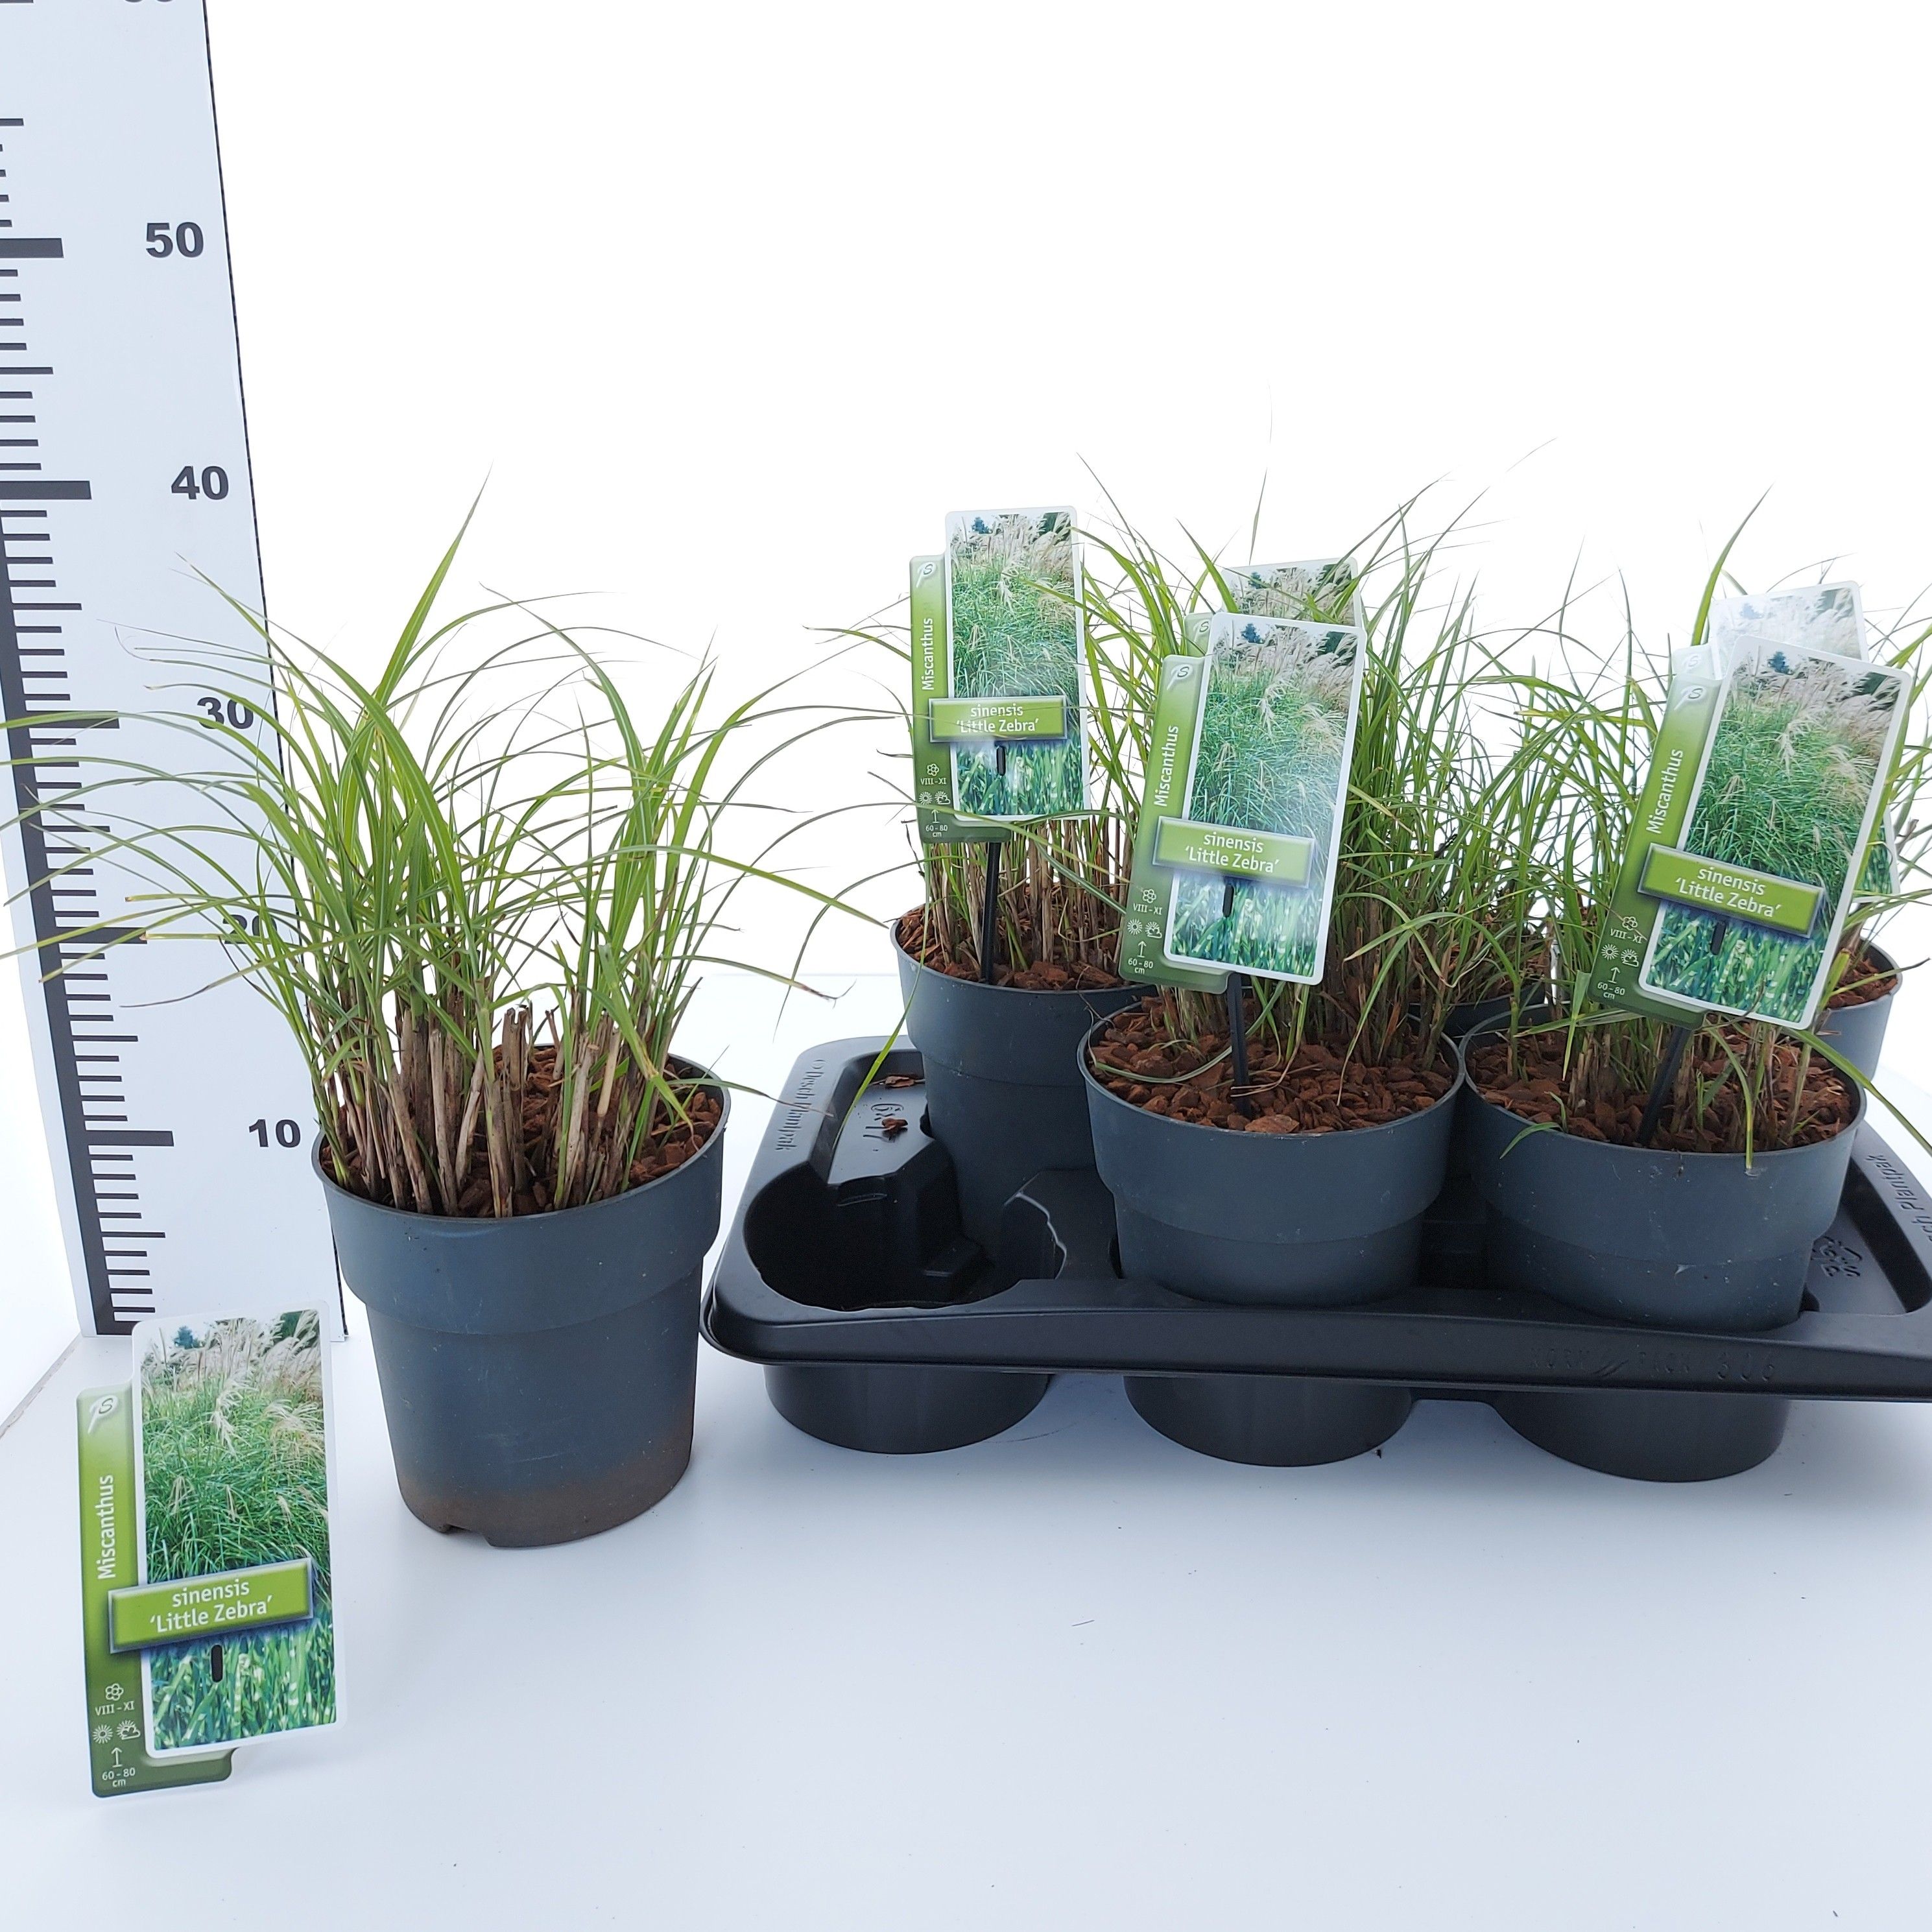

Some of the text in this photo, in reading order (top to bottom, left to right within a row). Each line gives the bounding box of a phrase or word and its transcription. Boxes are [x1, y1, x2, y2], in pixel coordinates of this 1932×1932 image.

[145, 222, 204, 257] 50
[171, 466, 229, 499] 40
[920, 618, 935, 690] Miscanthus
[197, 697, 254, 729] 30
[971, 702, 1023, 717] sinensis
[1154, 726, 1178, 807] Miscanthus
[1645, 748, 1684, 835] Miscanthus
[1204, 831, 1264, 853] sinensis
[1697, 866, 1766, 896] sinensis
[1128, 958, 1138, 966] 60
[1143, 960, 1154, 969] 80
[1597, 982, 1608, 990] 60
[1614, 986, 1625, 996] 80
[1603, 992, 1616, 1000] cm
[249, 1119, 301, 1148] 10
[1865, 1155, 1925, 1210] Plantpak
[95, 1475, 116, 1579] Miscanthus
[172, 1579, 250, 1608] sinensis
[102, 1771, 114, 1780] 60
[123, 1767, 136, 1777] 80
